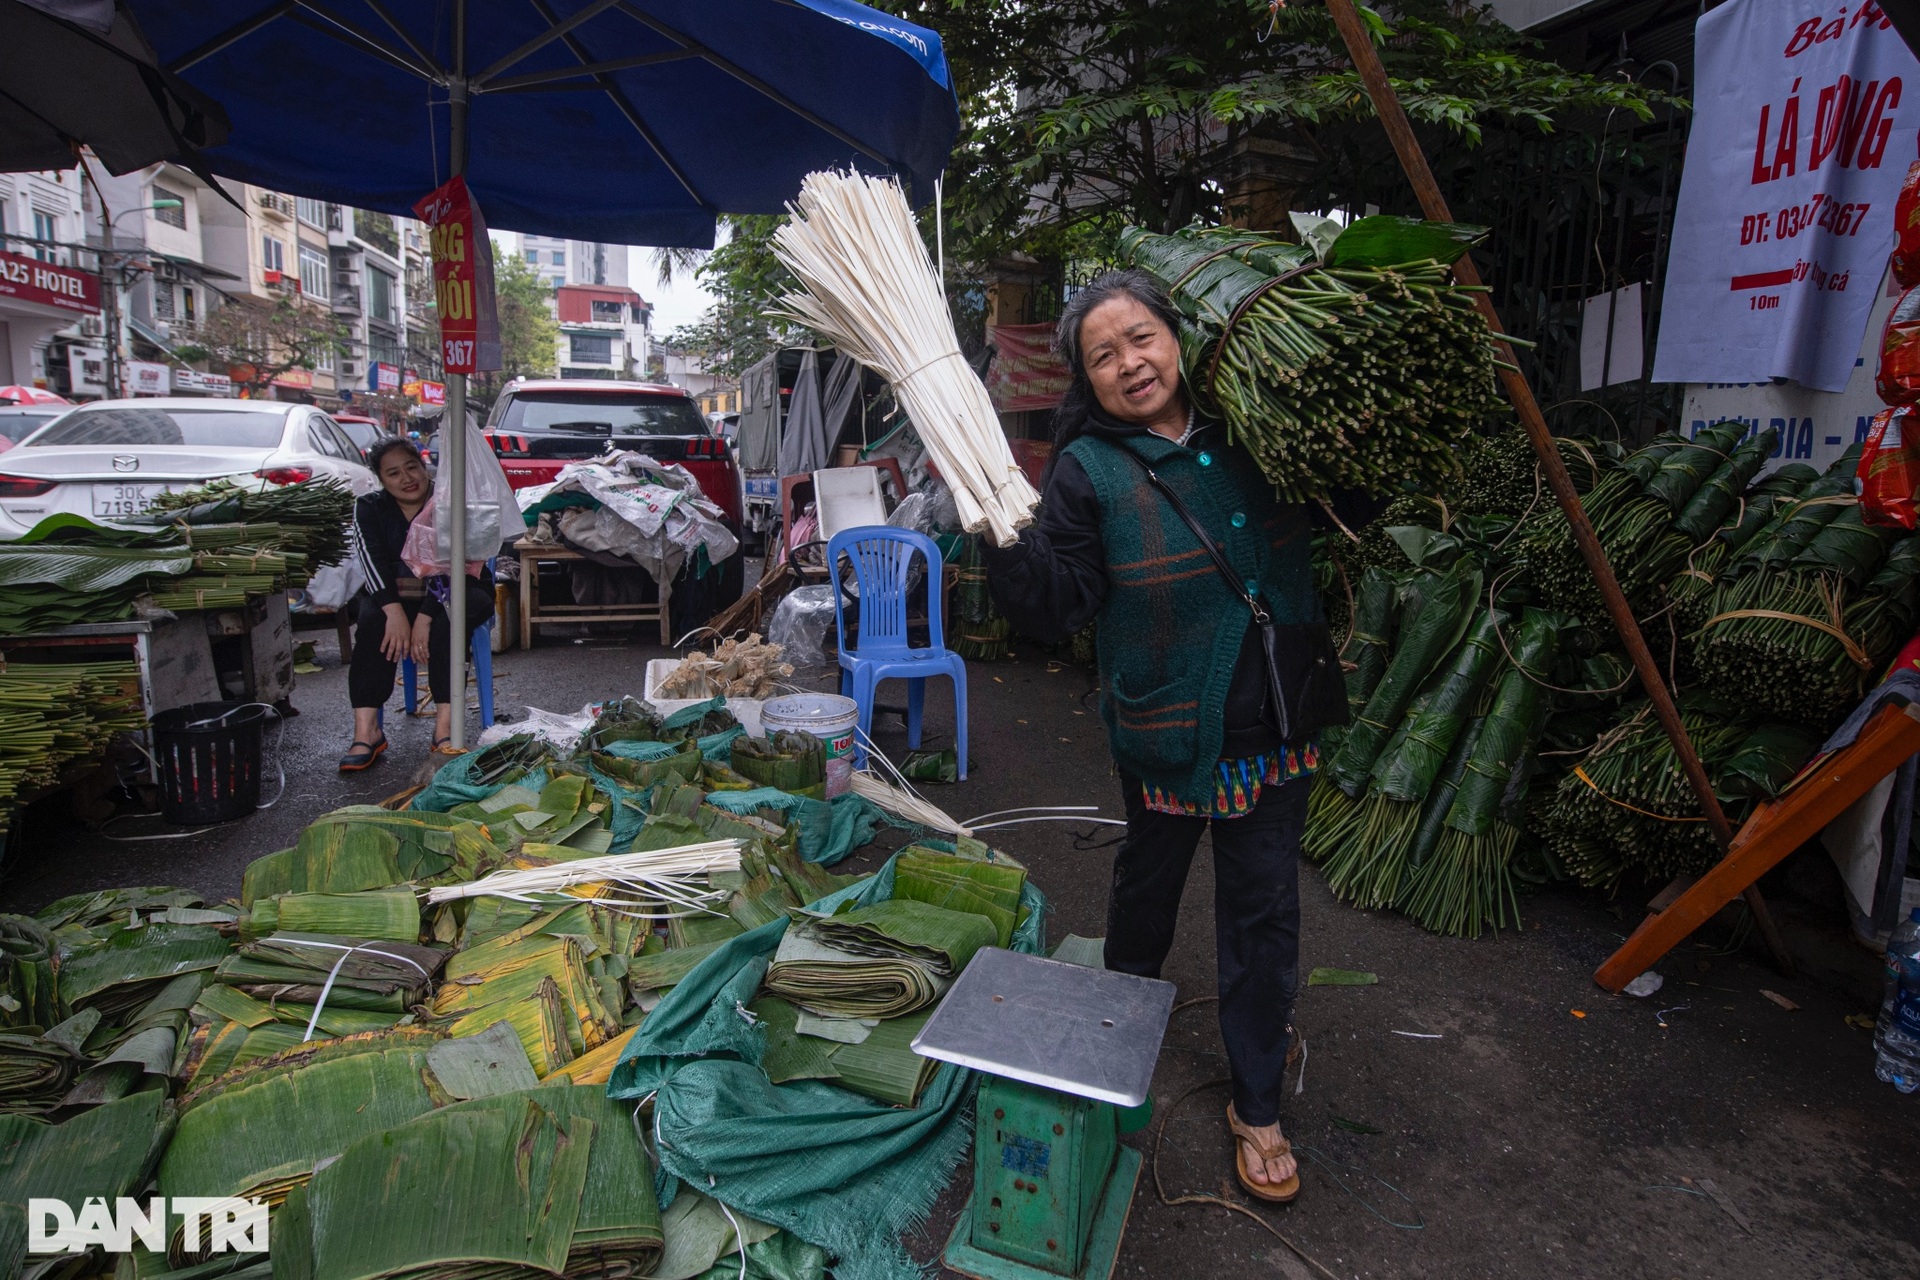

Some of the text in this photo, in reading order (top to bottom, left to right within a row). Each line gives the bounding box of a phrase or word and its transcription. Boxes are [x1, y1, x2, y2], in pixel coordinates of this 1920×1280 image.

[1751, 76, 1802, 184] LÁ
[1740, 212, 1770, 246] ĐT:
[0, 258, 86, 299] A25 HOTEL
[1828, 270, 1849, 291] cá
[1750, 295, 1779, 311] 10m
[445, 340, 473, 366] 367
[1769, 416, 1814, 460] BIA
[114, 487, 146, 500] 30K
[1901, 1003, 1920, 1021] AQU
